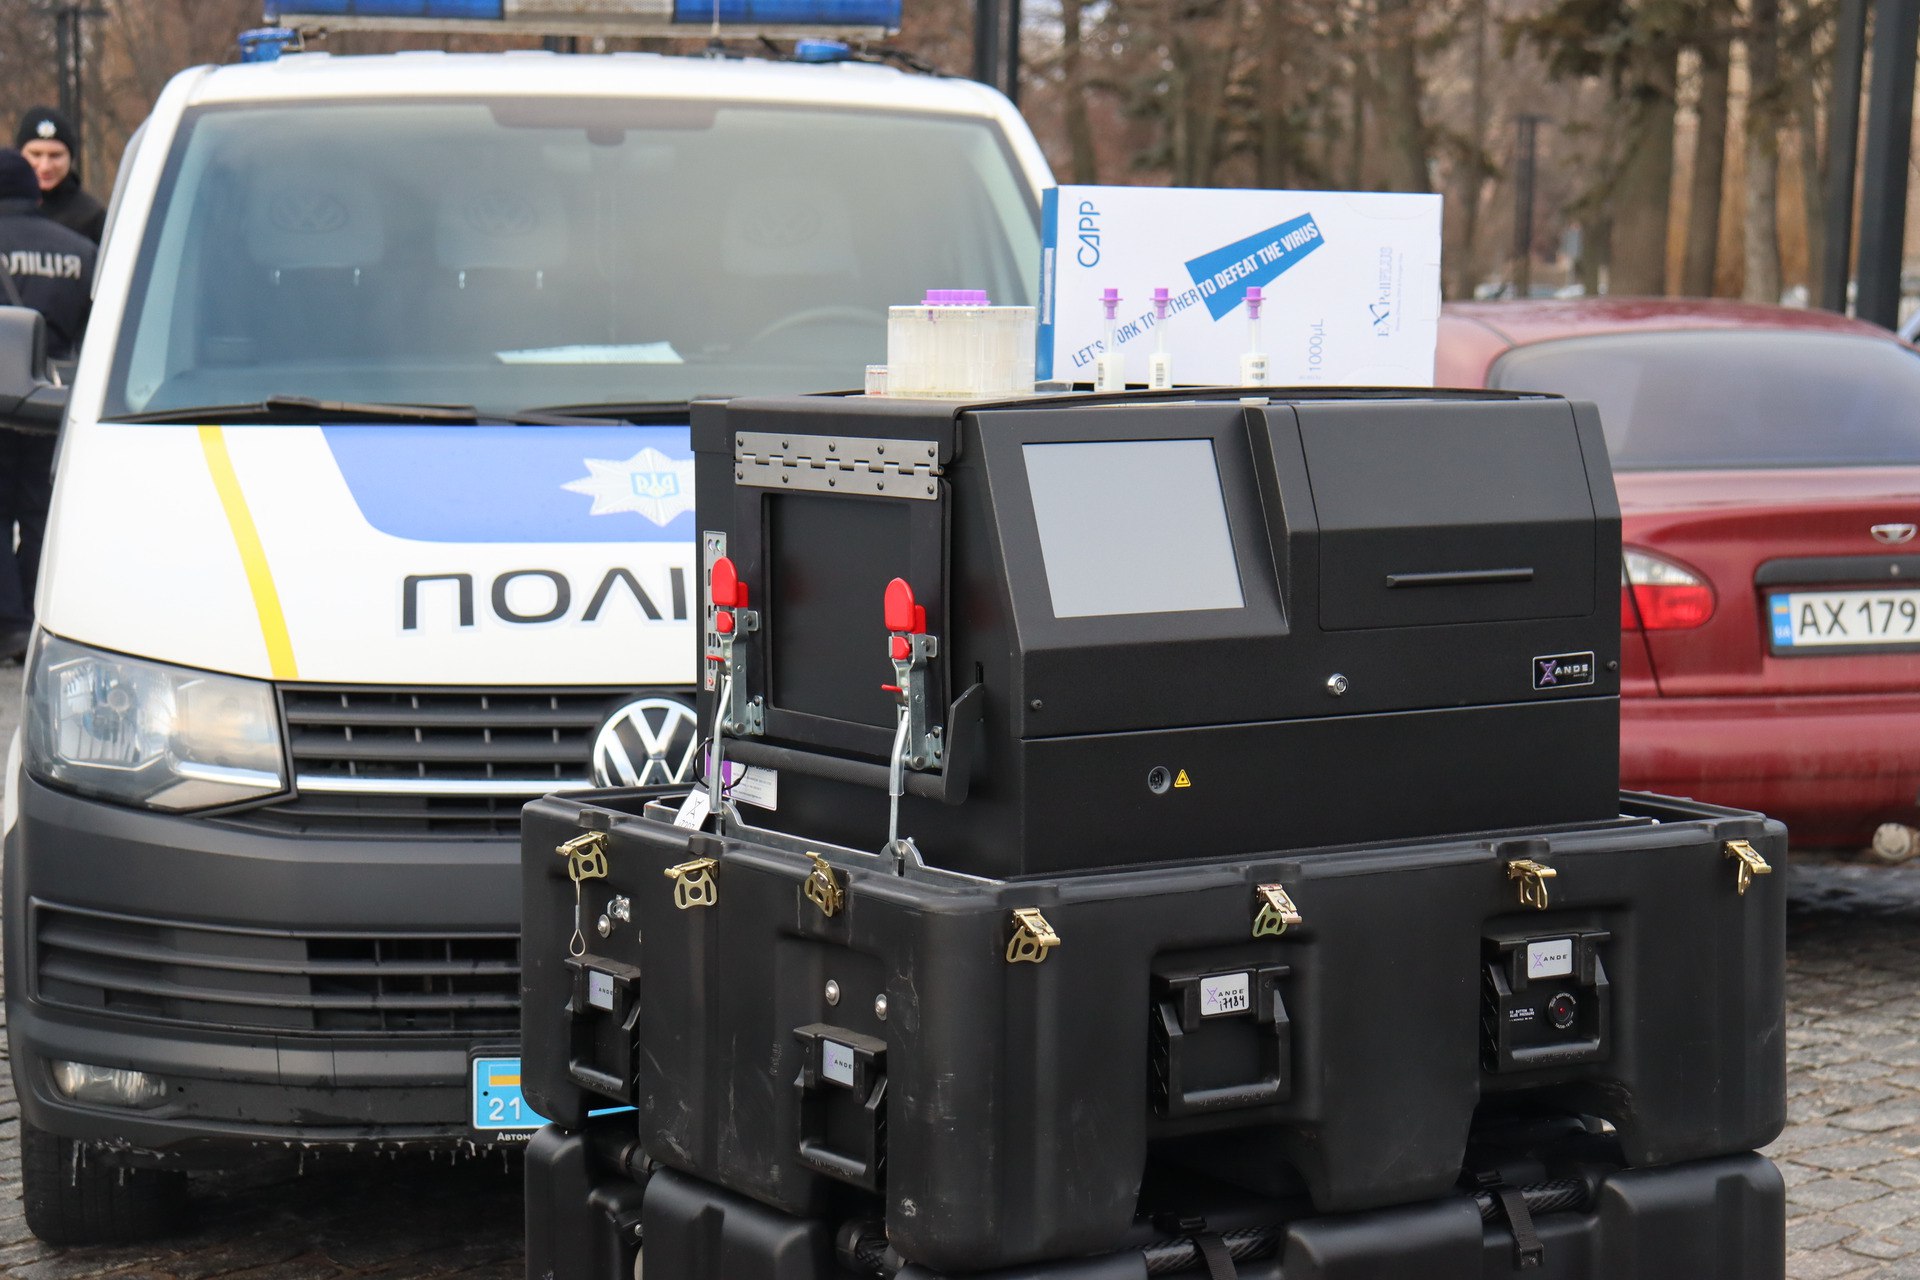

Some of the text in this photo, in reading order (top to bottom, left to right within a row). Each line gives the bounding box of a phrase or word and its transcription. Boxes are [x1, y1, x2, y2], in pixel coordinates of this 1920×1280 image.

[1077, 201, 1101, 267] CAPP
[1071, 340, 1105, 368] LET'S
[1116, 320, 1142, 345] ORK
[1196, 278, 1217, 298] TO
[1213, 254, 1260, 290] DEFEAT
[1256, 240, 1285, 265] THE
[1280, 222, 1319, 252] VIRUS
[403, 567, 688, 630] ПОЛІ
[1800, 600, 1847, 635] AX
[1543, 954, 1568, 962] ANDE
[1218, 989, 1244, 997] ANDE
[834, 1060, 853, 1070] ANDE
[488, 1096, 521, 1121] 21
